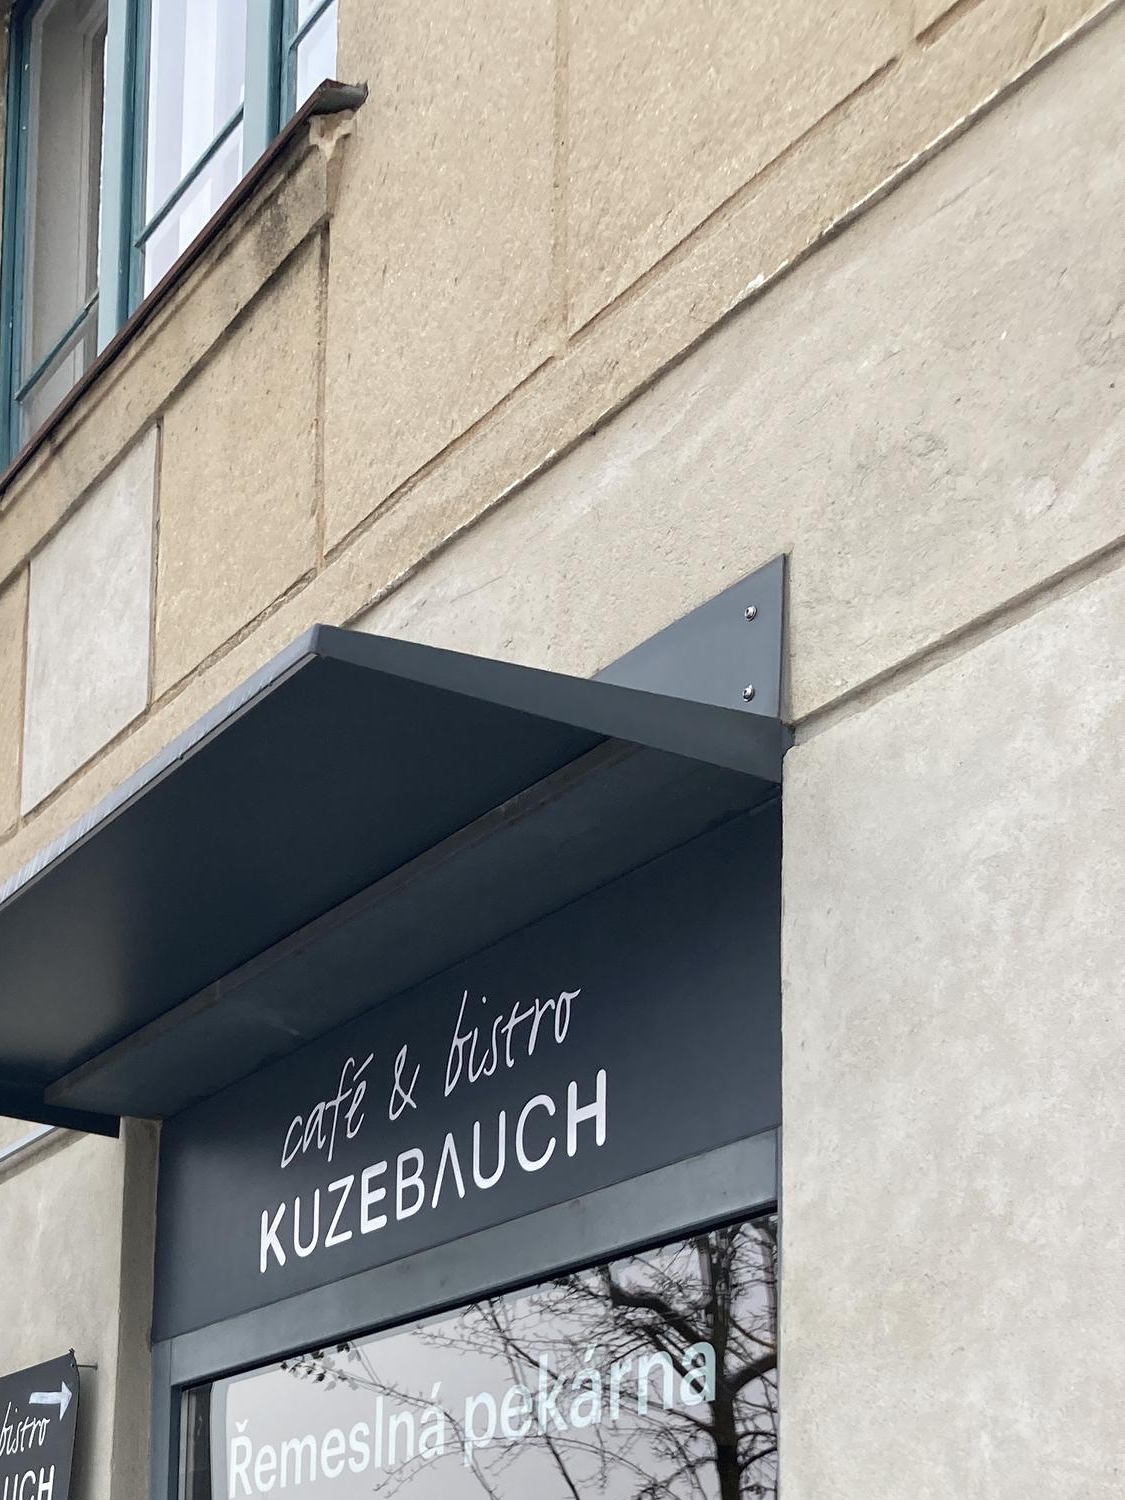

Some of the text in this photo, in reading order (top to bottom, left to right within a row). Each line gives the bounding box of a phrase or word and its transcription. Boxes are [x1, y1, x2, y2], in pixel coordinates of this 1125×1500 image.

[280, 989, 581, 1169] café & bistro
[259, 1069, 606, 1273] KUZEBAUCH
[227, 1340, 717, 1498] Řemeslná pekárna
